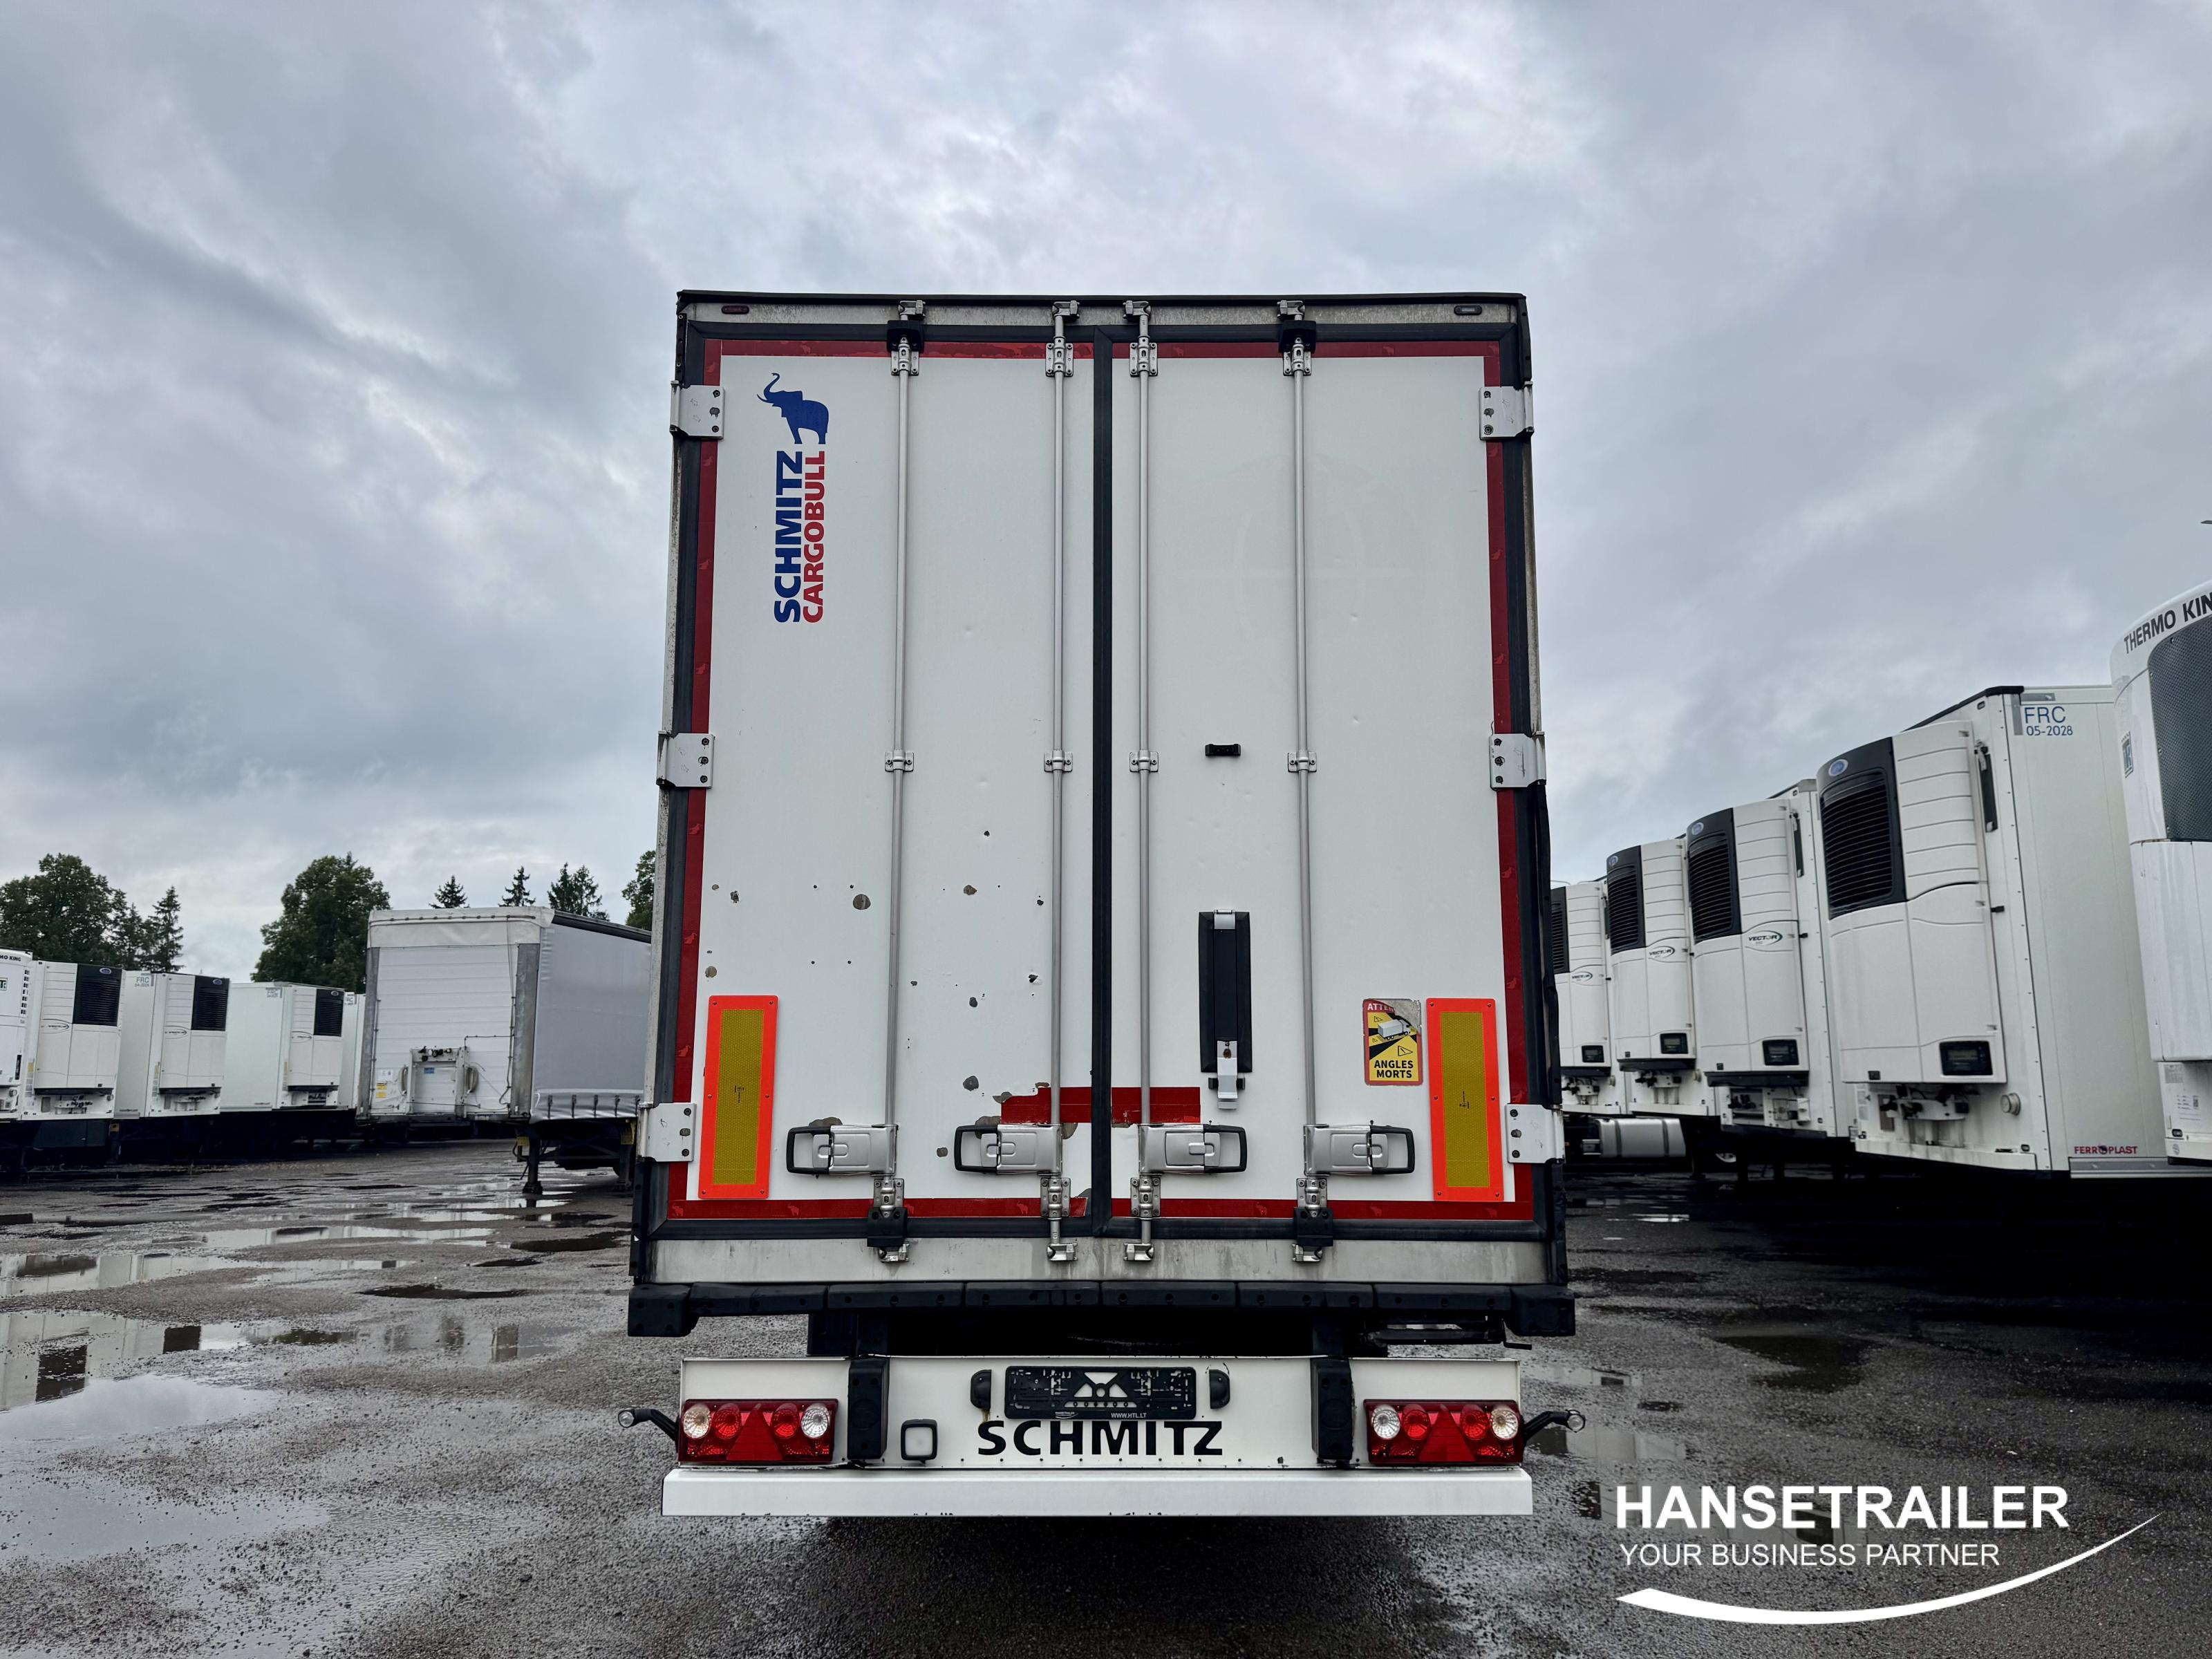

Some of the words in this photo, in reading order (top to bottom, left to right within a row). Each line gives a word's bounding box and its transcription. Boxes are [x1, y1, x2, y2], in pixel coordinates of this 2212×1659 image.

[774, 451, 803, 623] SCHMITZ
[803, 451, 825, 623] CARGOBULL
[2124, 610, 2176, 654] THERMO
[2025, 706, 2066, 723] FRC
[2026, 726, 2073, 735] 05-2028
[1374, 1060, 1414, 1069] ANGLES
[1377, 1070, 1412, 1078] MORTS
[978, 1421, 1223, 1456] SCHMITZ
